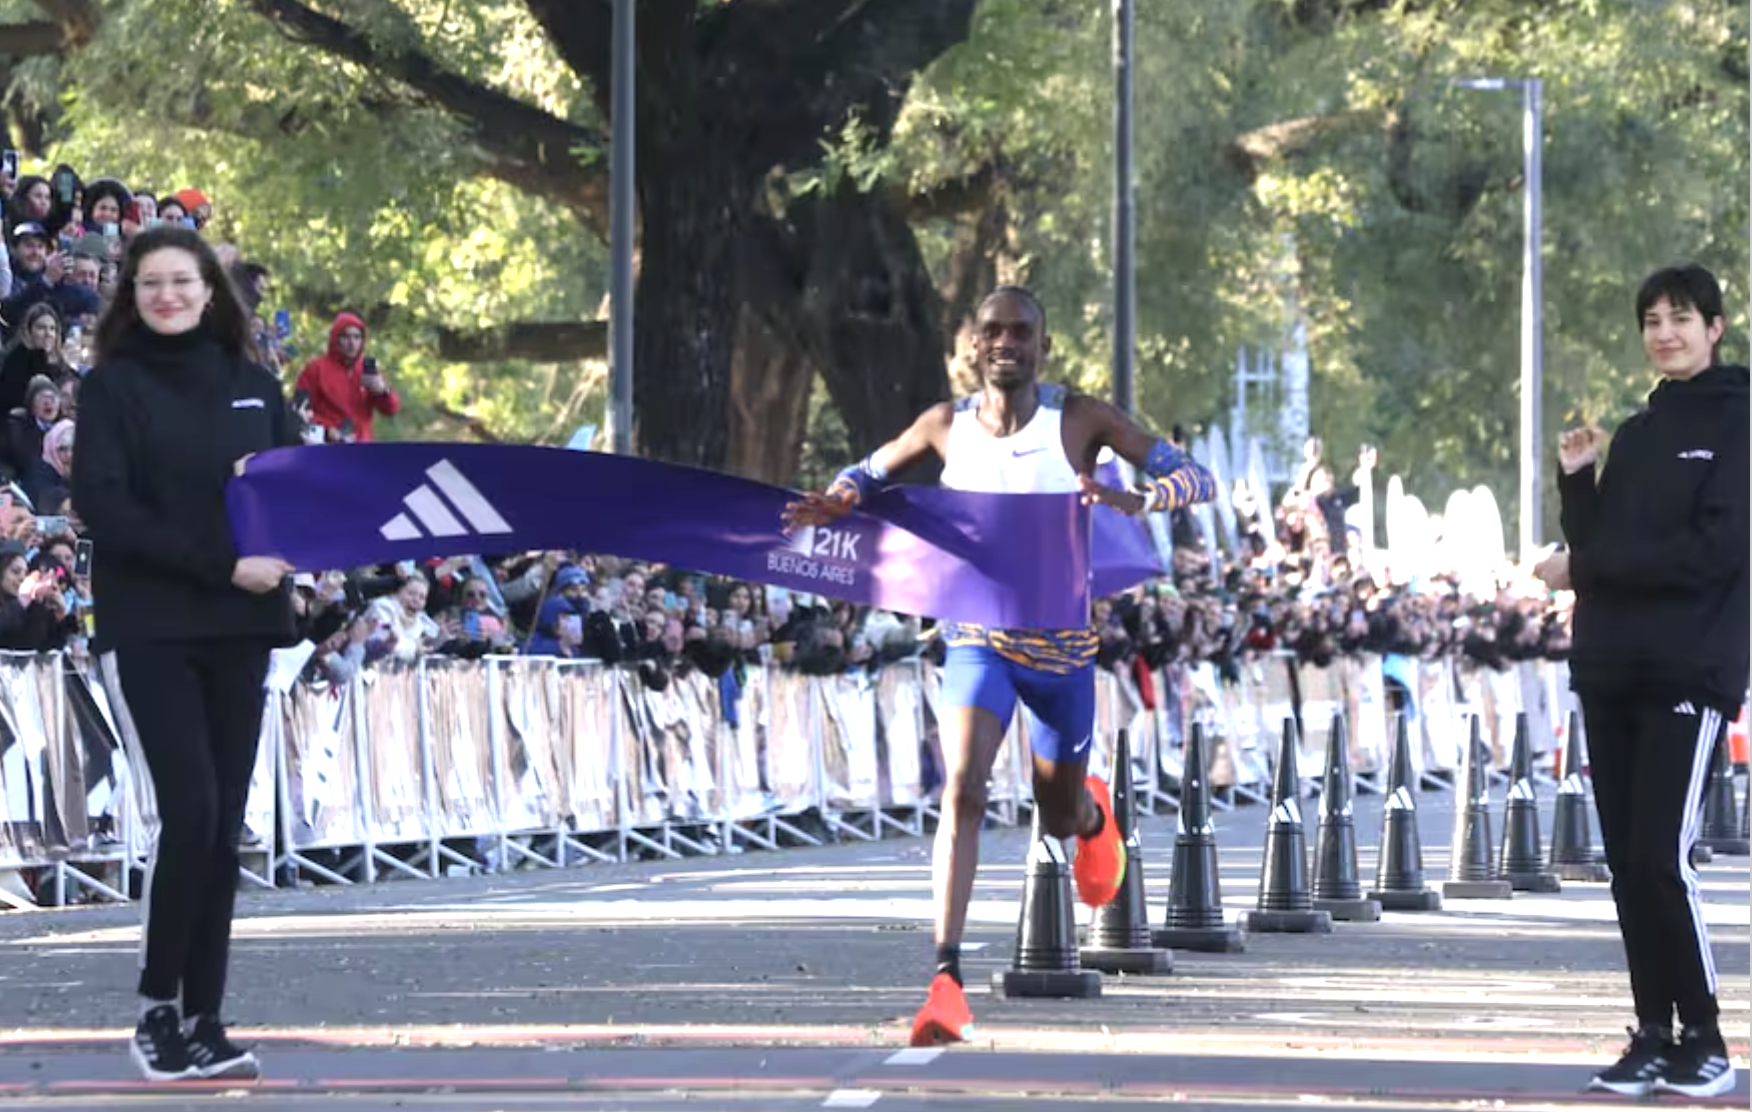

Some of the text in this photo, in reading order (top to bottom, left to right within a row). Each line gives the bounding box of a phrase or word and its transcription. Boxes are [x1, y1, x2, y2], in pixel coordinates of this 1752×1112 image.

[814, 527, 861, 561] 21K
[767, 553, 855, 586] BUENOS AIRES
